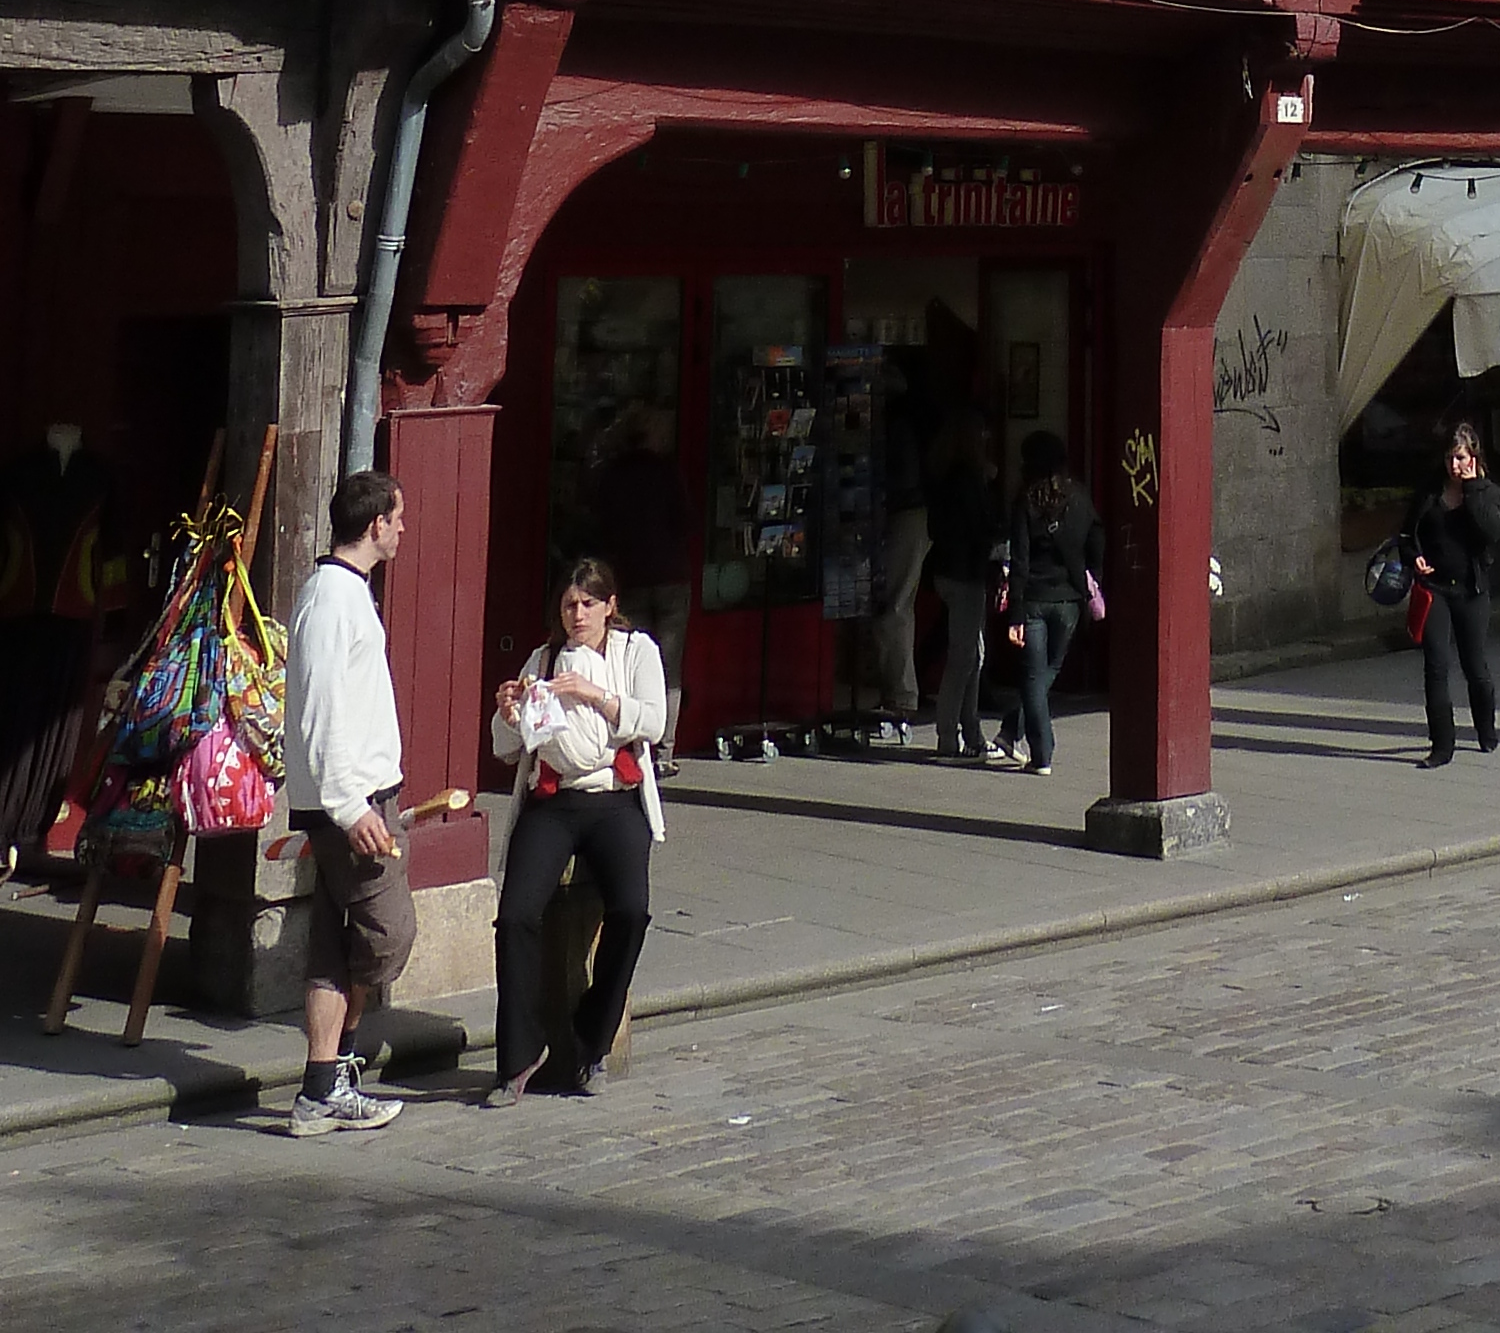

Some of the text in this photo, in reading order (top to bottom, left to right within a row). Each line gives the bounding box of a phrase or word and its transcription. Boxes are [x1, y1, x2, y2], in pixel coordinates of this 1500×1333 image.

[1285, 102, 1298, 118] 12
[864, 141, 1079, 226] la trinitaine
